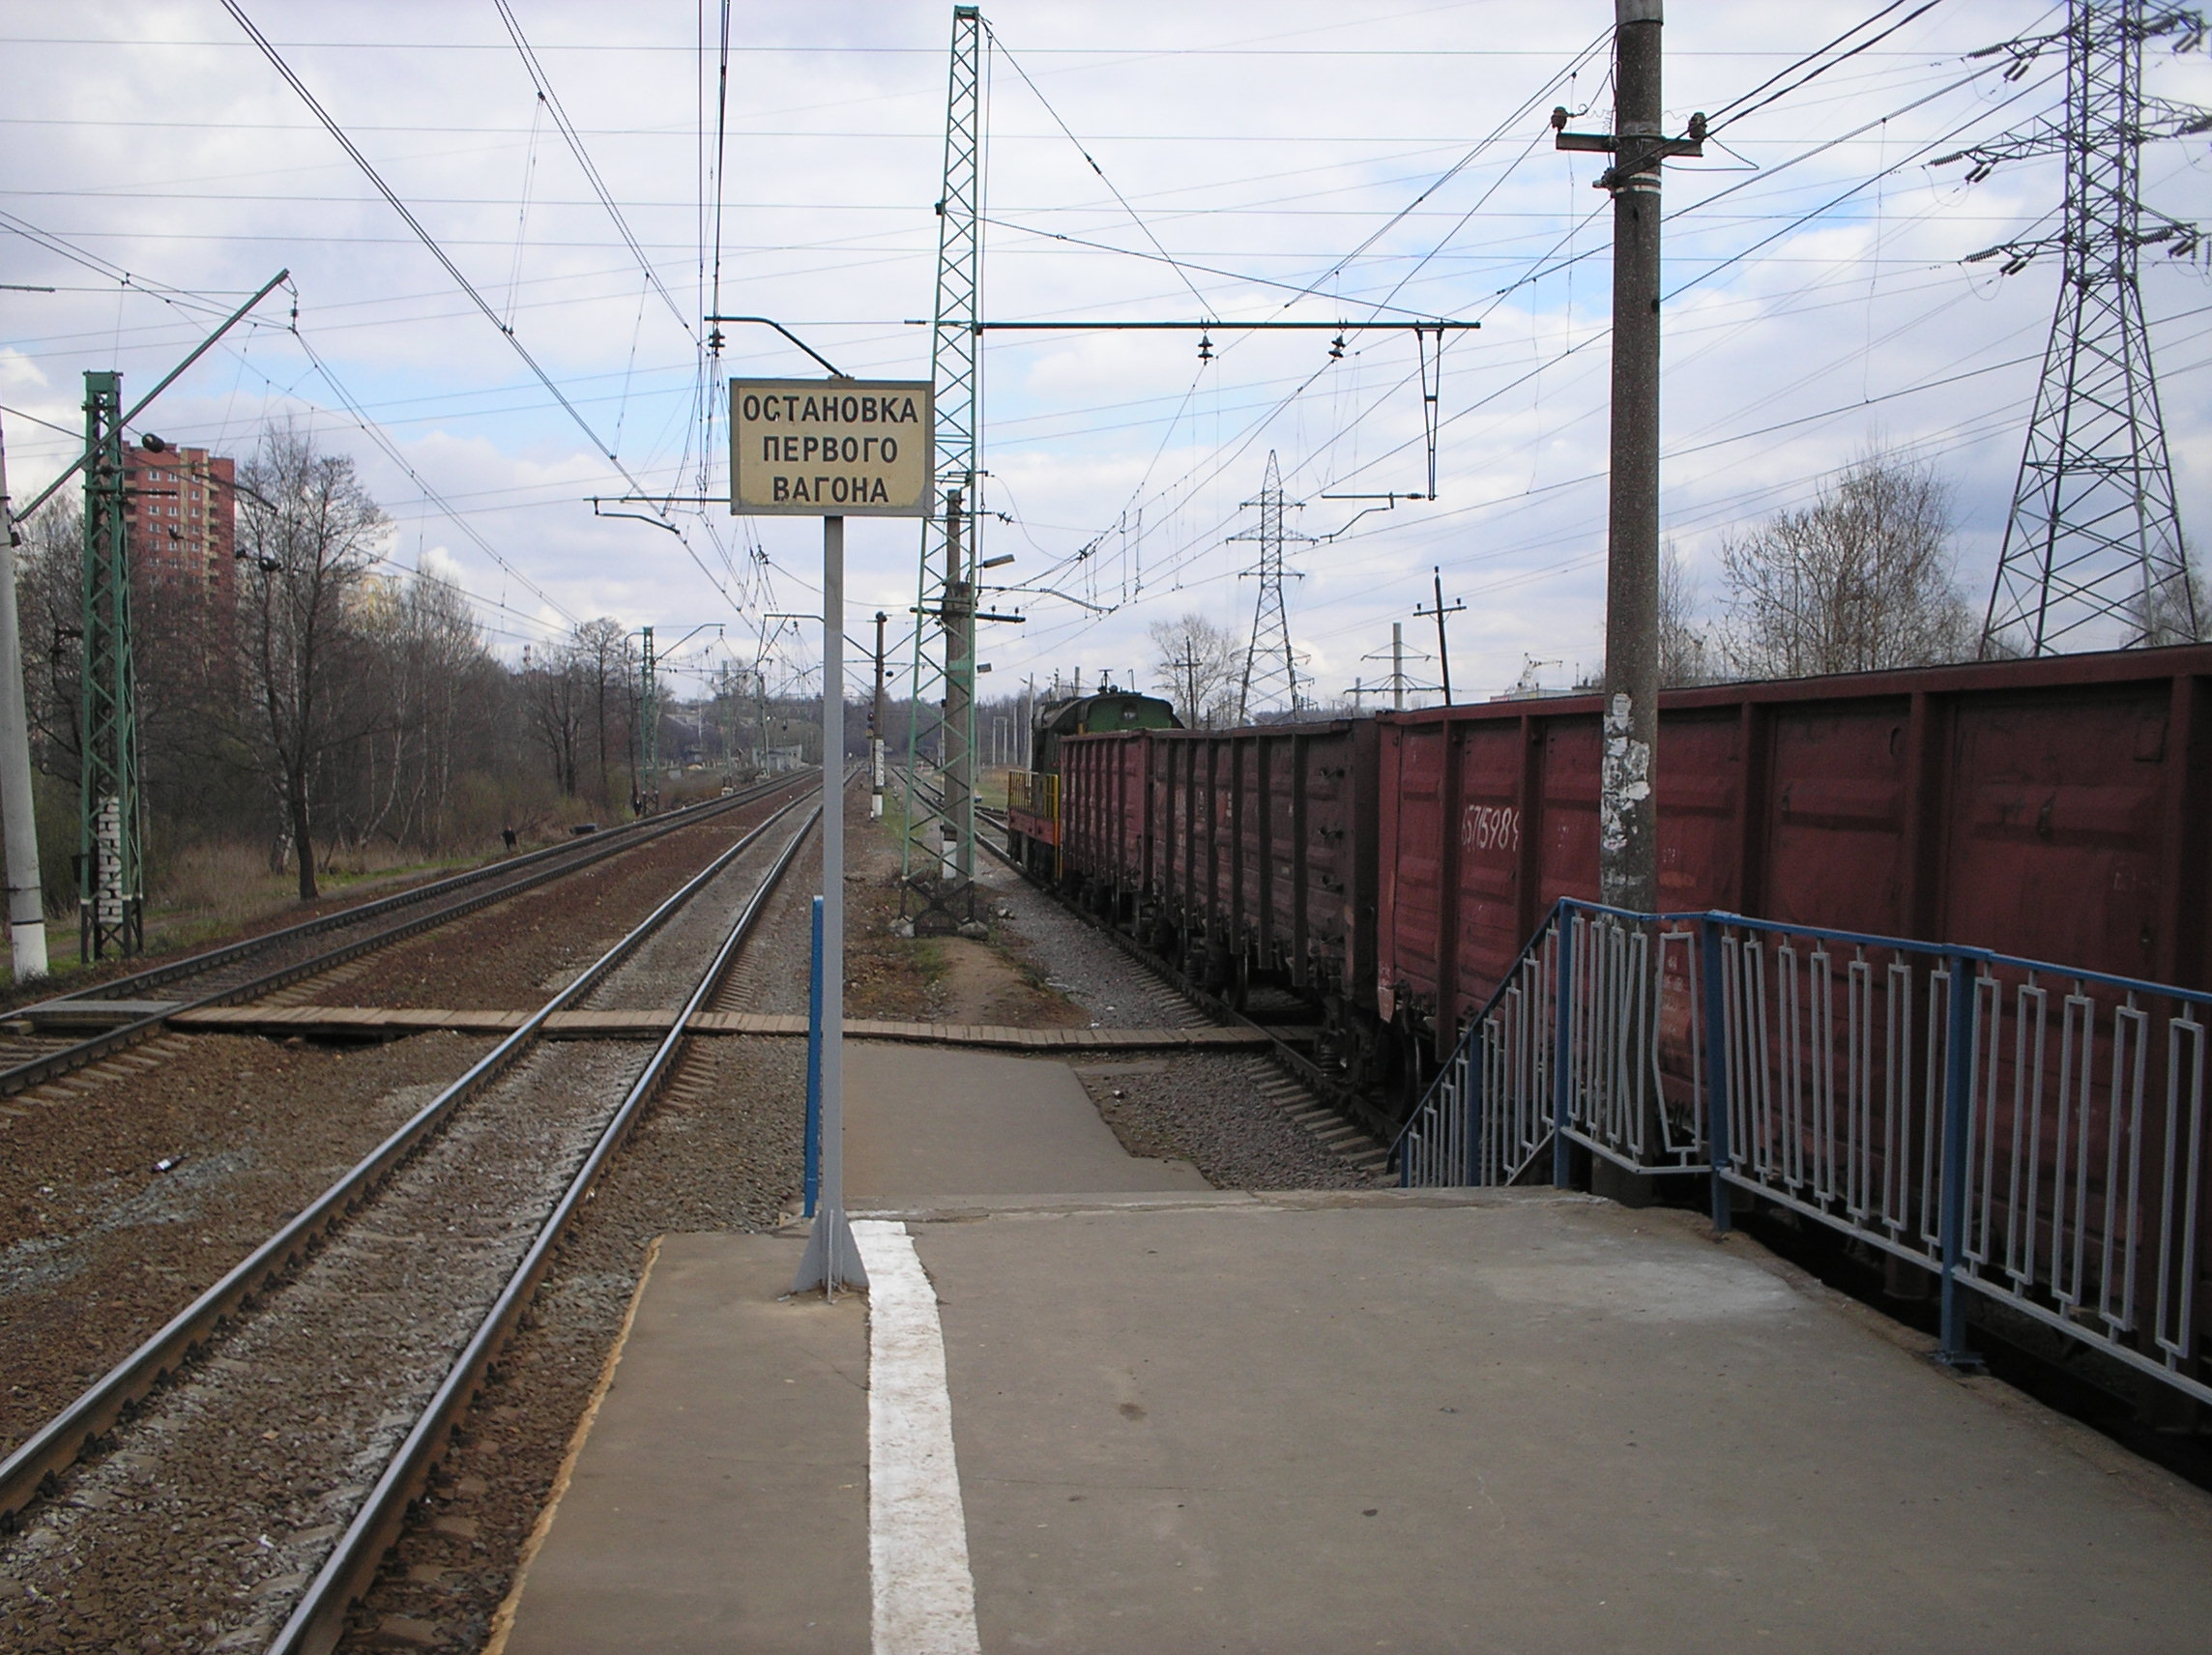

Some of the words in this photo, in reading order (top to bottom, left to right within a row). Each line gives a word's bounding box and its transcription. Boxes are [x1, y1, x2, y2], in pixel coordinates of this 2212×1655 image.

[743, 394, 917, 422] ОСТАНОВКА
[763, 436, 897, 463] ПЕРВОГО
[773, 476, 888, 503] ВАГОНА
